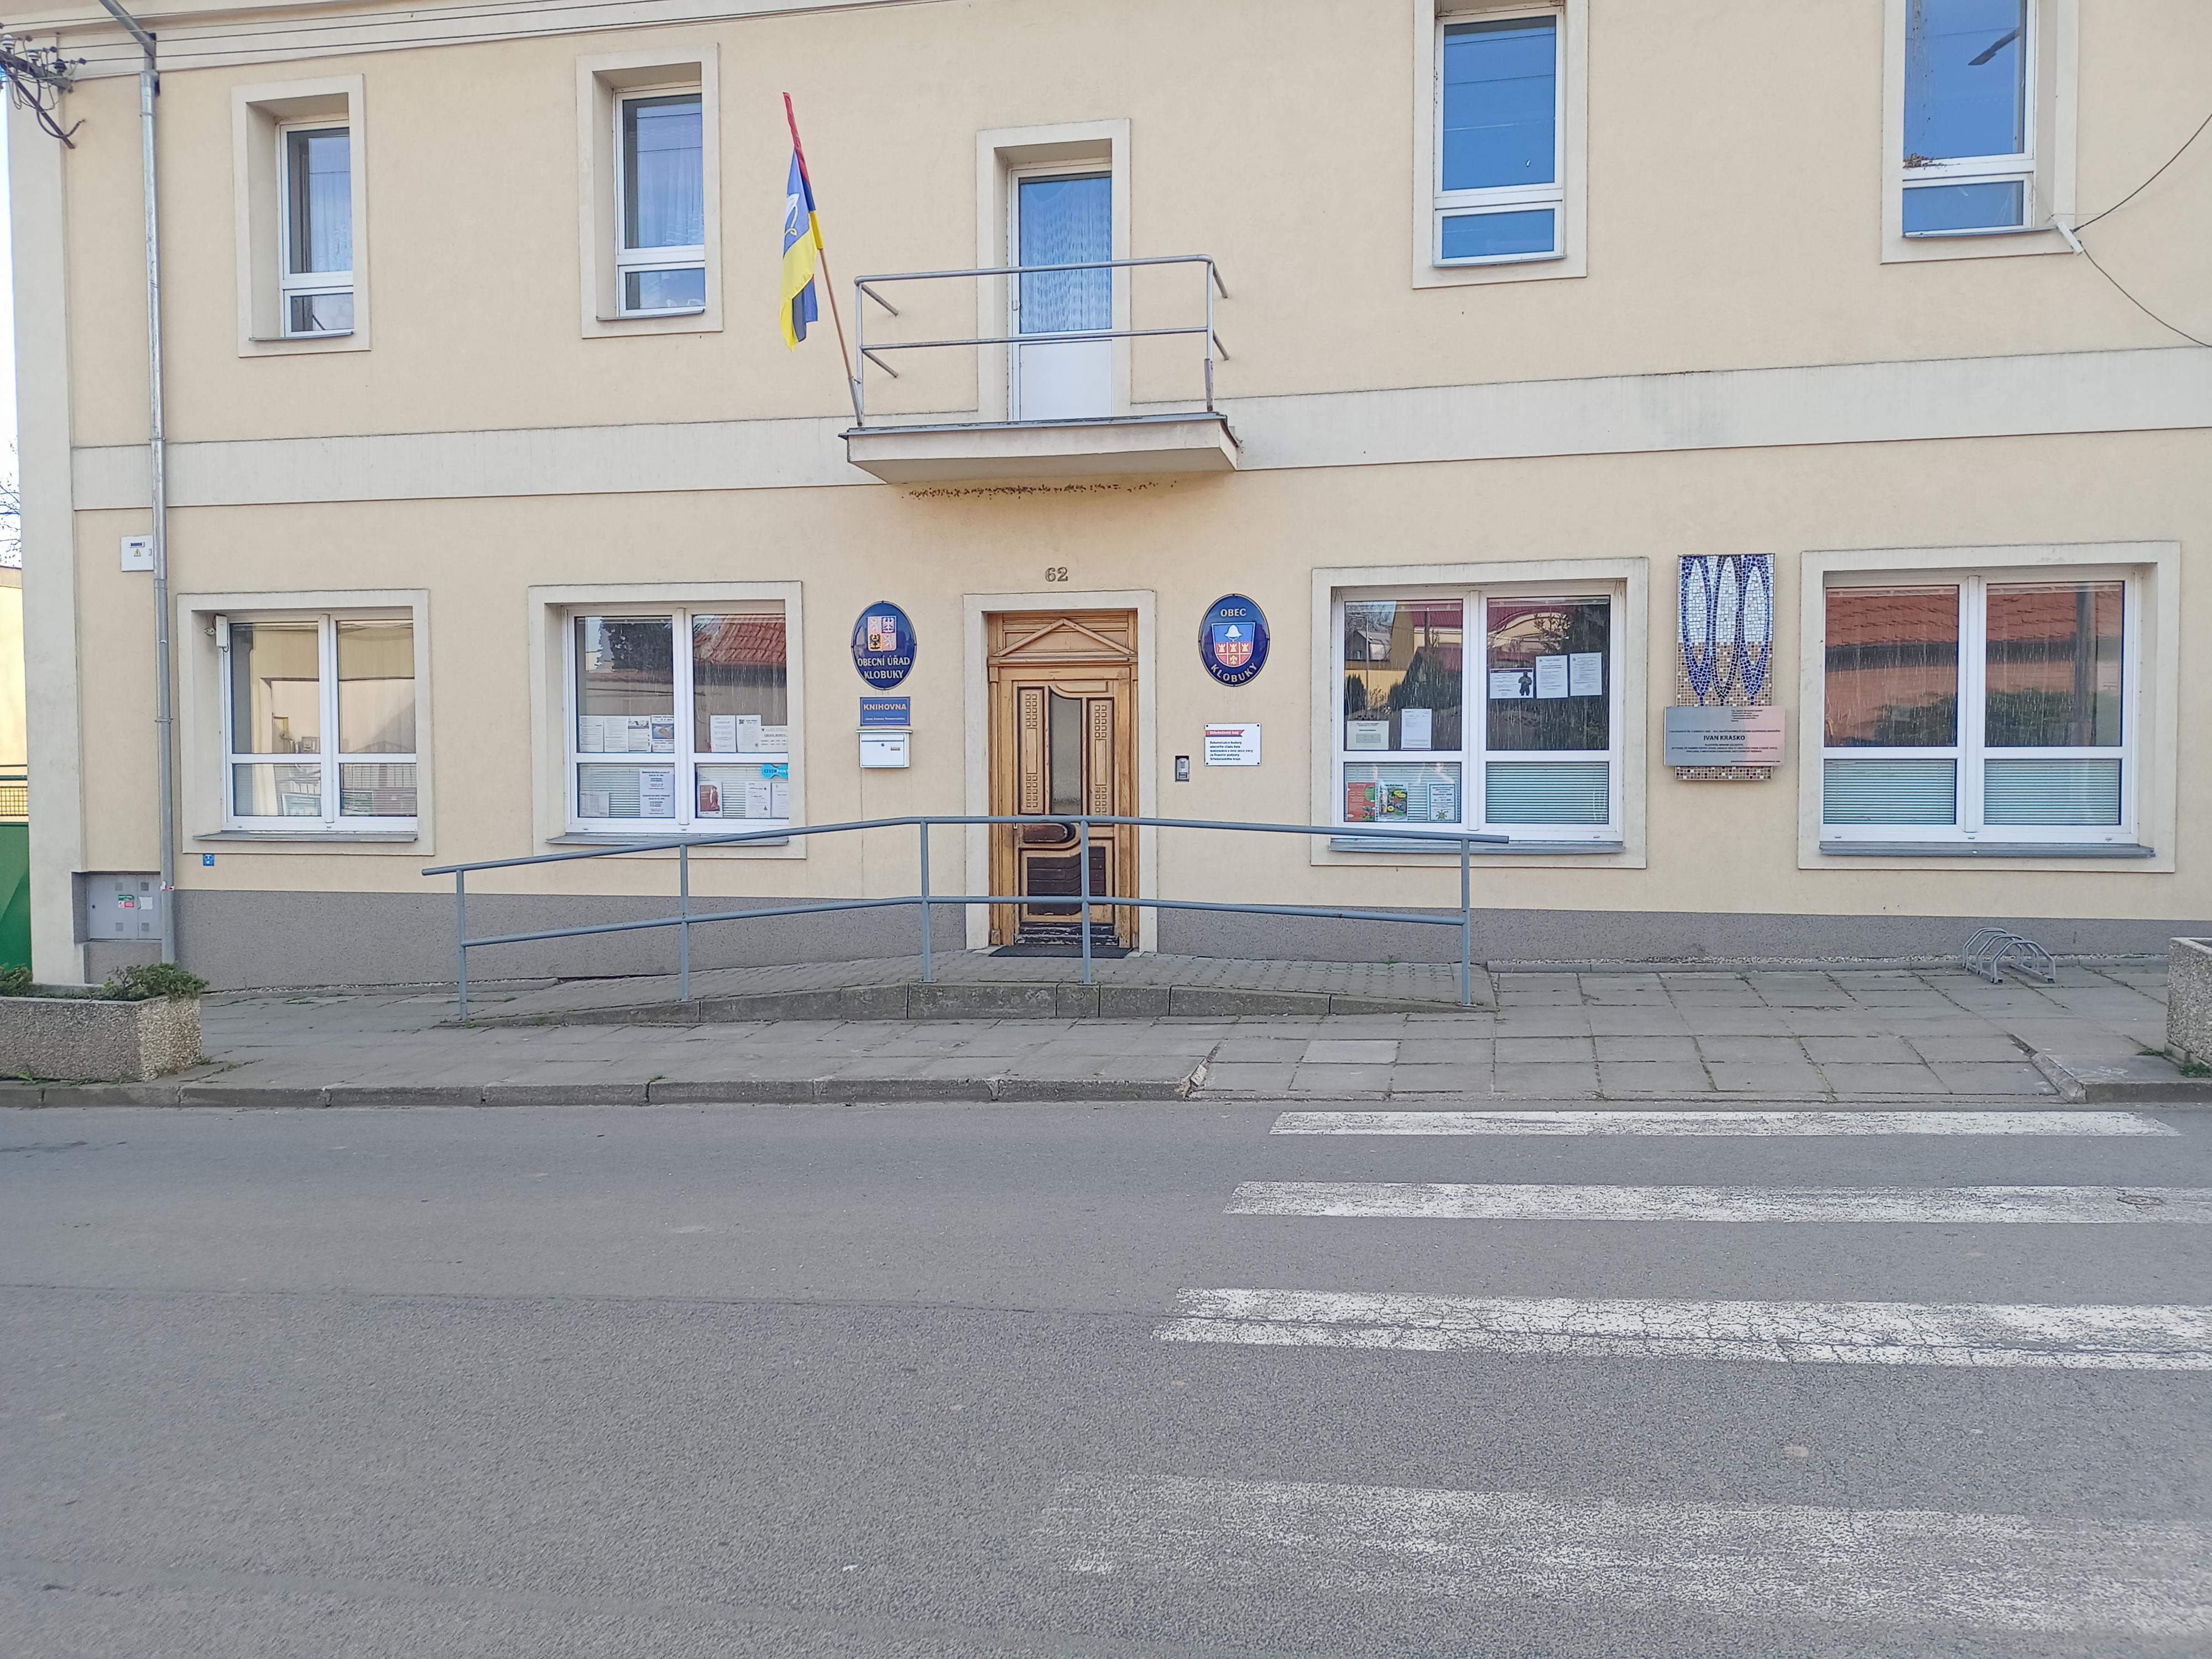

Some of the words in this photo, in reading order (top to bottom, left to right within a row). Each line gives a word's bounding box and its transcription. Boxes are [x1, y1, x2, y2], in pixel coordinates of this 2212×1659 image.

[1045, 566, 1068, 582] 62
[1220, 609, 1246, 617] OBEC
[858, 655, 885, 667] OBECNÍ
[887, 655, 910, 666] ÚŘAD
[864, 670, 904, 680] KLOBUKY
[1211, 662, 1258, 682] KLOBUKY
